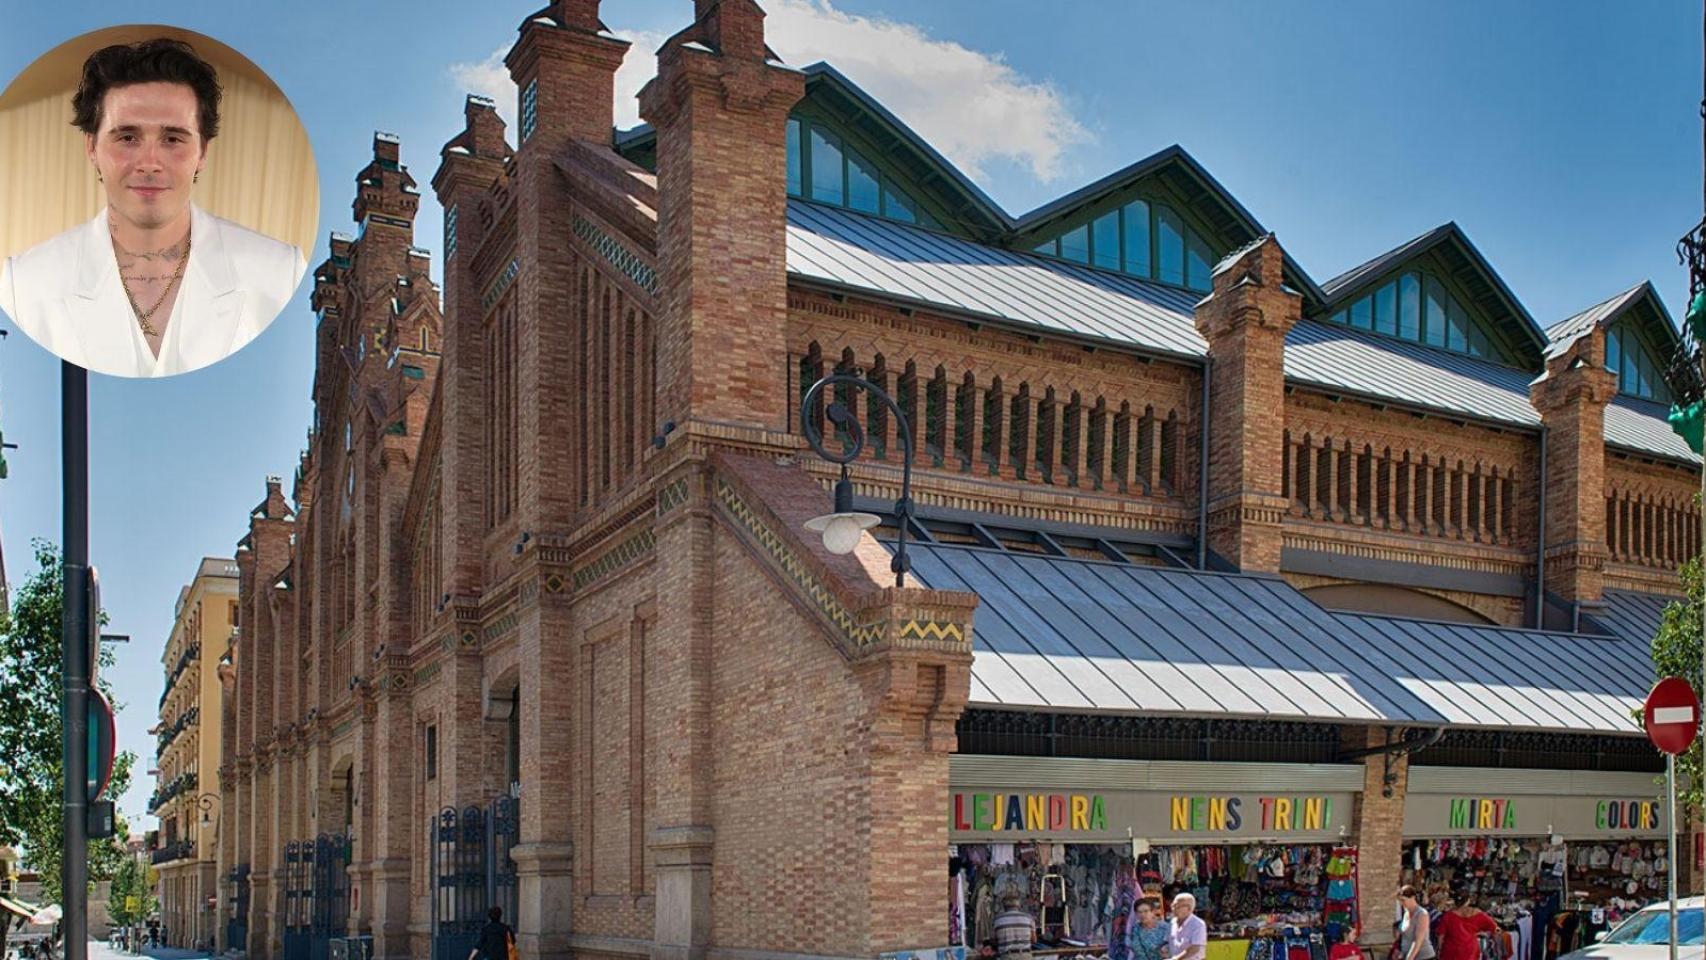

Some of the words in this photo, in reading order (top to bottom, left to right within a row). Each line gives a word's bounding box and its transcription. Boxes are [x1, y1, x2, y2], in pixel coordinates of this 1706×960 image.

[949, 794, 1107, 831] LEJANDRA
[1171, 797, 1241, 831] NENS
[1259, 797, 1333, 831] TRINI
[1449, 799, 1516, 829] MIRTA
[1595, 801, 1659, 829] COLORS
[1339, 825, 1346, 836] 2
